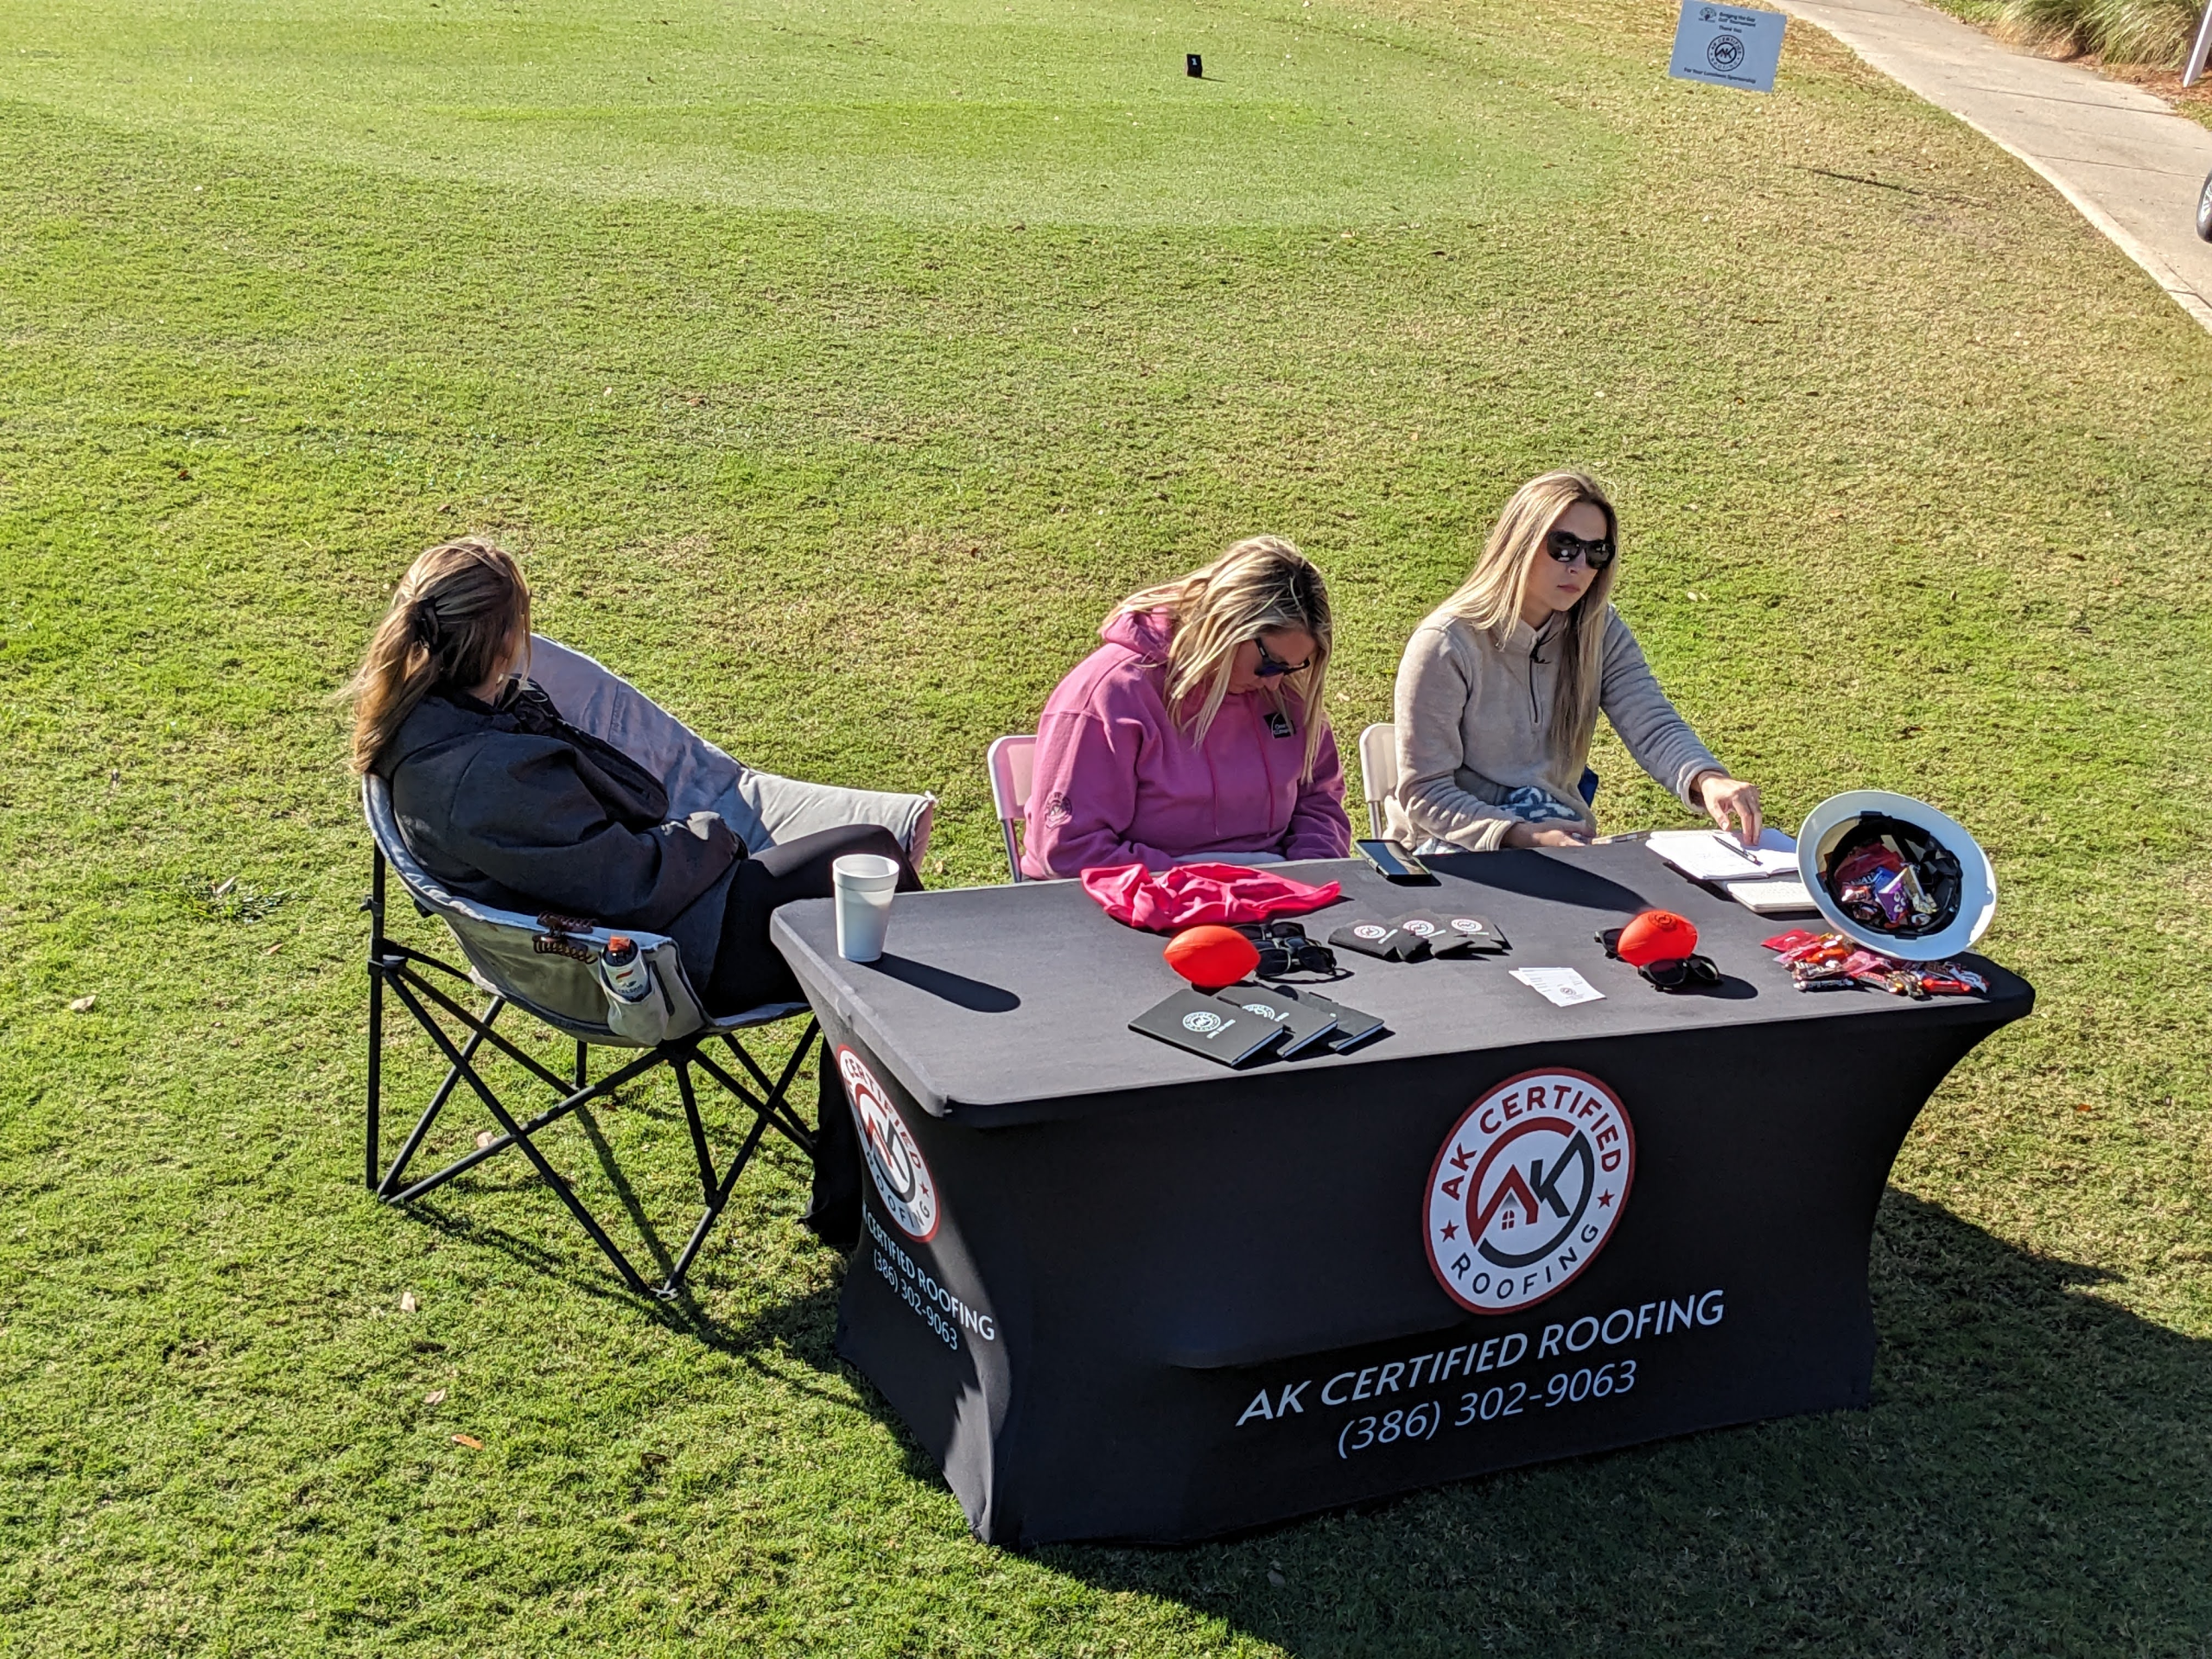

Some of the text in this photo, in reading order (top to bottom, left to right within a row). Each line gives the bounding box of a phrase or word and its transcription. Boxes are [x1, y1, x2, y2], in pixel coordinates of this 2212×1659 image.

[844, 1058, 922, 1169] CERTIFIED
[1441, 1084, 1622, 1201] AK CERTIFIED
[867, 1211, 995, 1341] CERTIFIED ROOFING
[874, 1249, 958, 1351] (386) 302-9063
[1451, 1223, 1599, 1300] ROOFING
[1235, 1289, 1725, 1427] AK CERTIFIED ROOFING
[1338, 1359, 1637, 1459] (386) 302-9063
